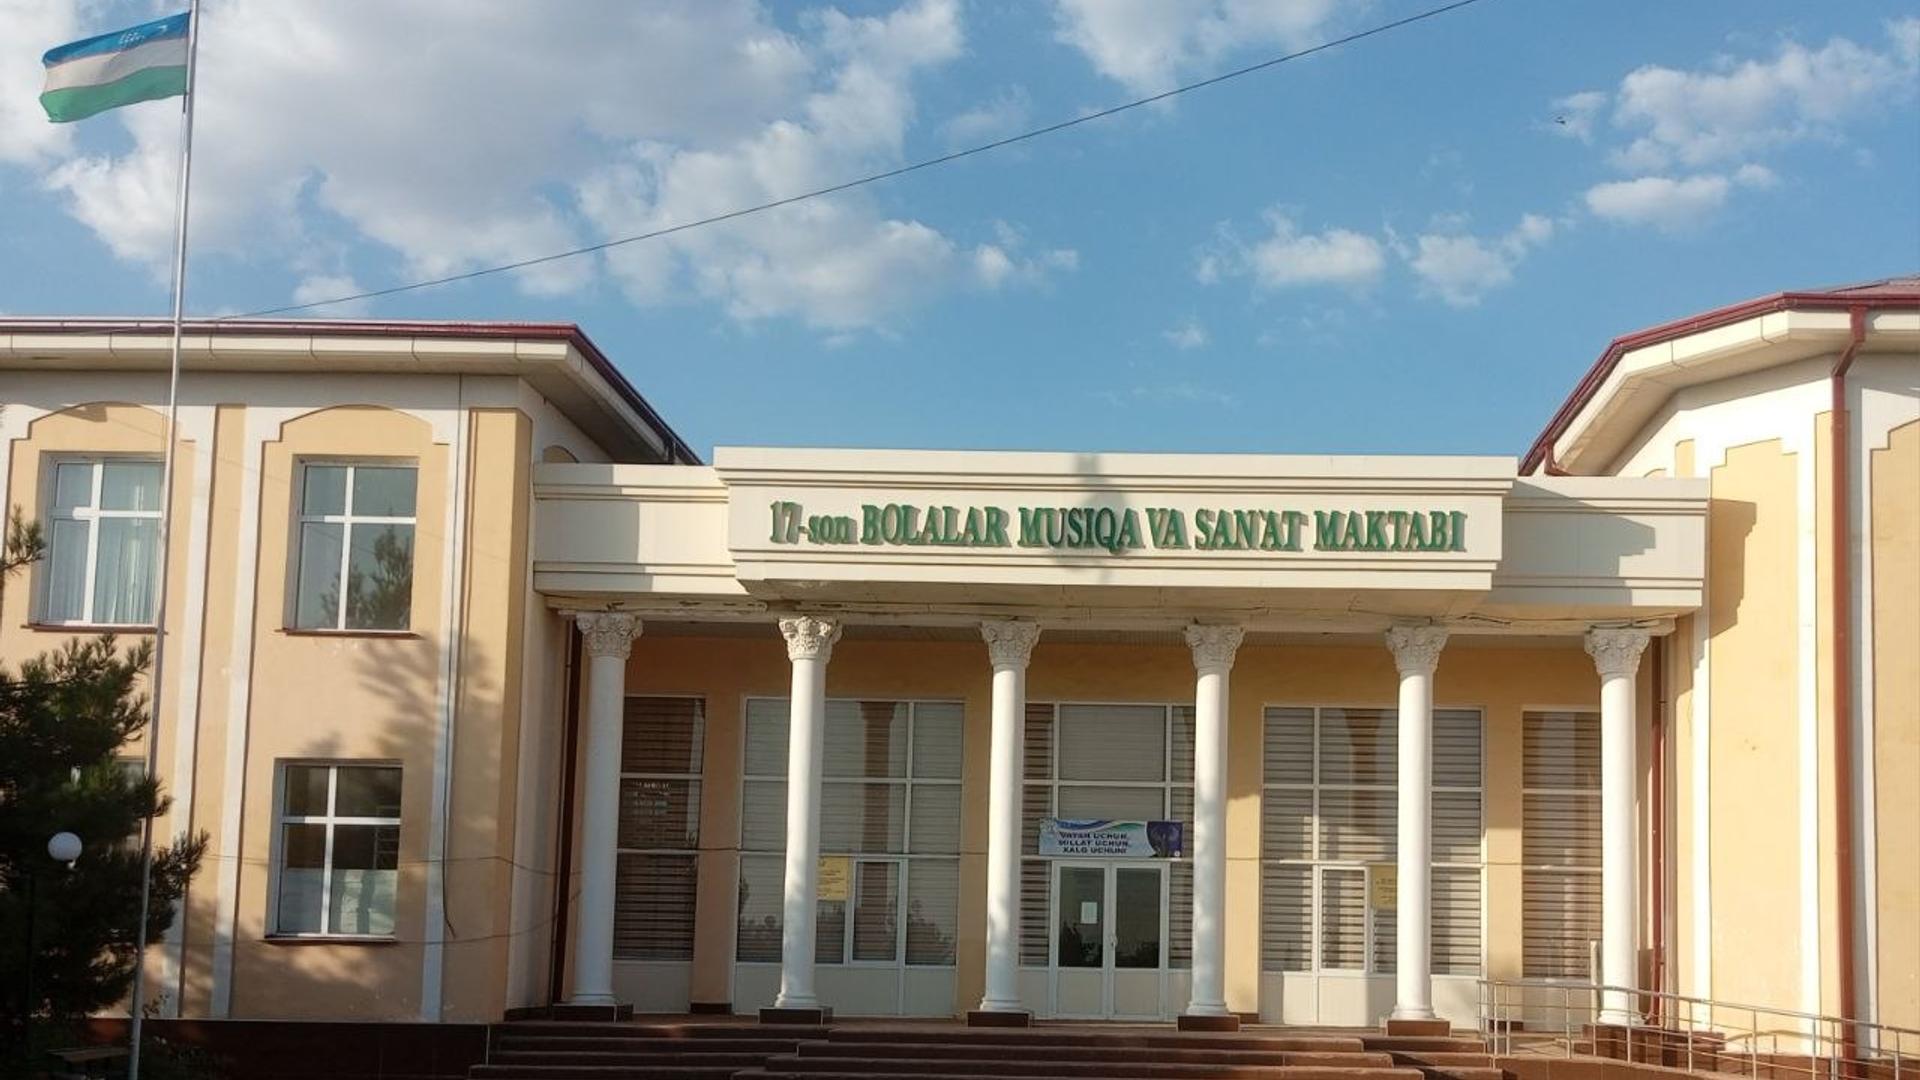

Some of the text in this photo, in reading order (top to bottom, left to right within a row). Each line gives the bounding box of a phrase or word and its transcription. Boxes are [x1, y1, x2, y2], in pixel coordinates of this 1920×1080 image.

[770, 501, 858, 545] 17-son
[860, 503, 1012, 548] BOLALAR
[1017, 507, 1146, 555] MUSIQA
[1145, 507, 1192, 550] VA
[1313, 509, 1468, 553] MAKTABI
